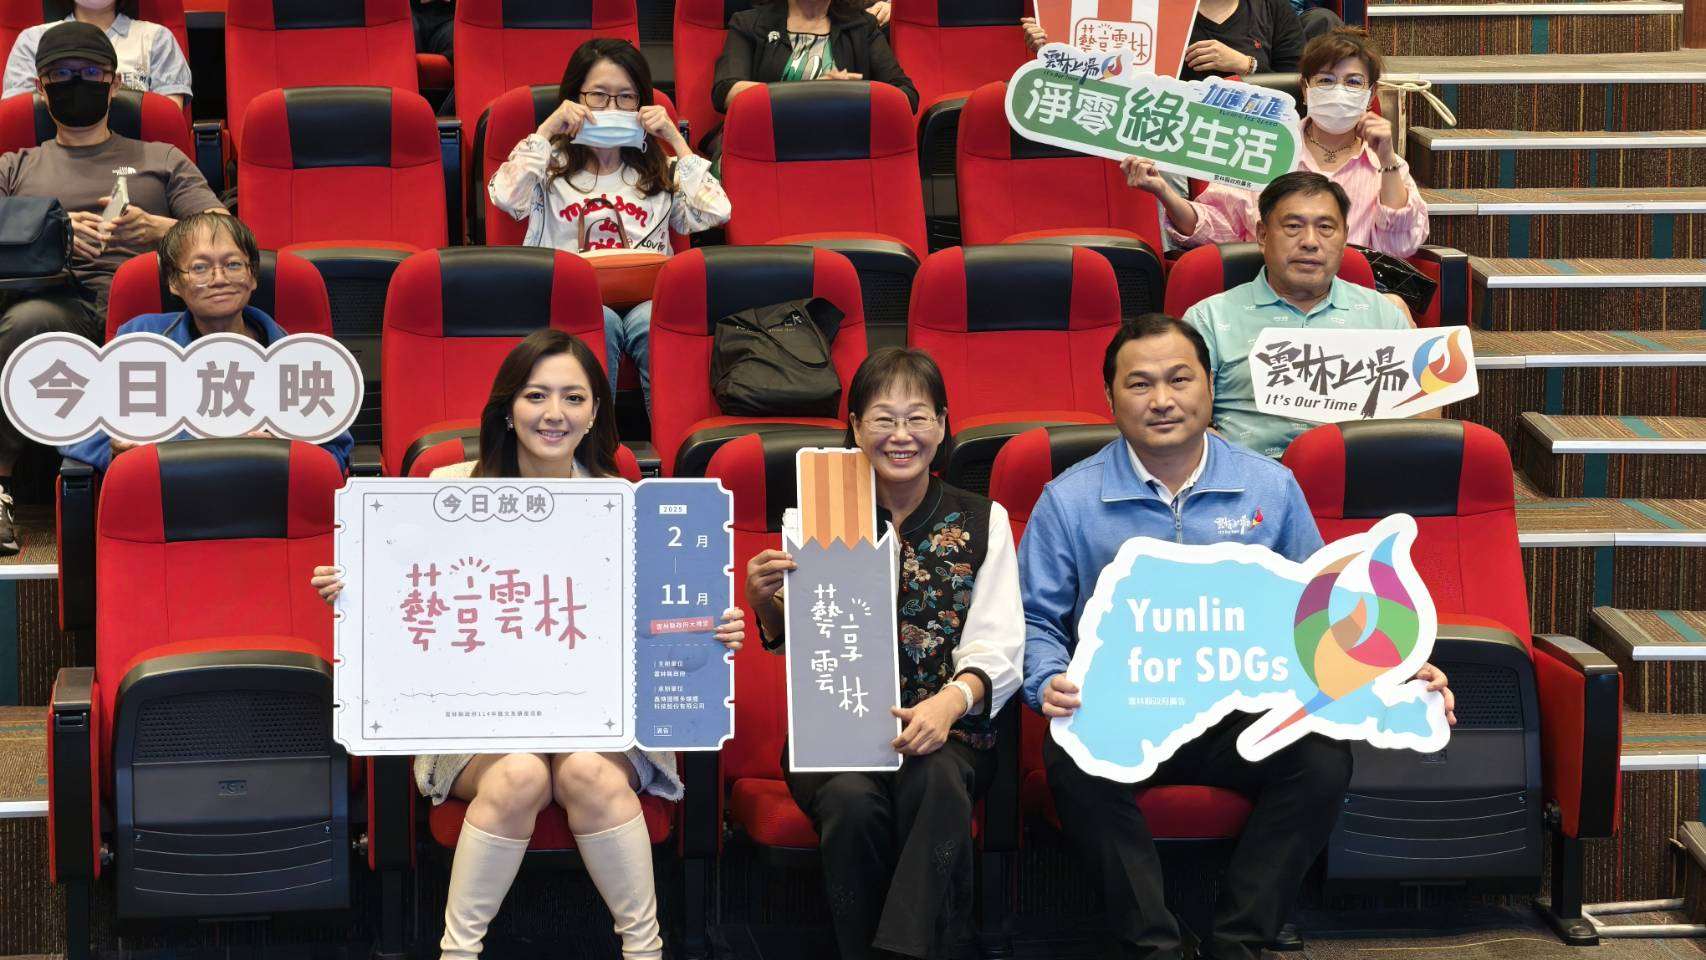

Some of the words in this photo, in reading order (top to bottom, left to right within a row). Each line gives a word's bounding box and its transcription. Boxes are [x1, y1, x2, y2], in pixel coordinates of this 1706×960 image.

[1023, 77, 1279, 176] 淨零綠生活
[29, 358, 336, 420] 今日放映
[1255, 340, 1409, 420] 雲林上場
[1265, 393, 1290, 406] It's
[1295, 395, 1321, 409] Our
[1323, 398, 1357, 412] Time
[441, 493, 546, 514] 今日放映
[667, 526, 682, 547] 2
[696, 535, 708, 548] 月
[400, 556, 587, 653] 藝享雲林
[661, 583, 690, 605] 11
[697, 592, 708, 605] 月
[1127, 596, 1245, 632] Yunlin
[1127, 647, 1181, 682] for
[1196, 647, 1289, 682] SDGs
